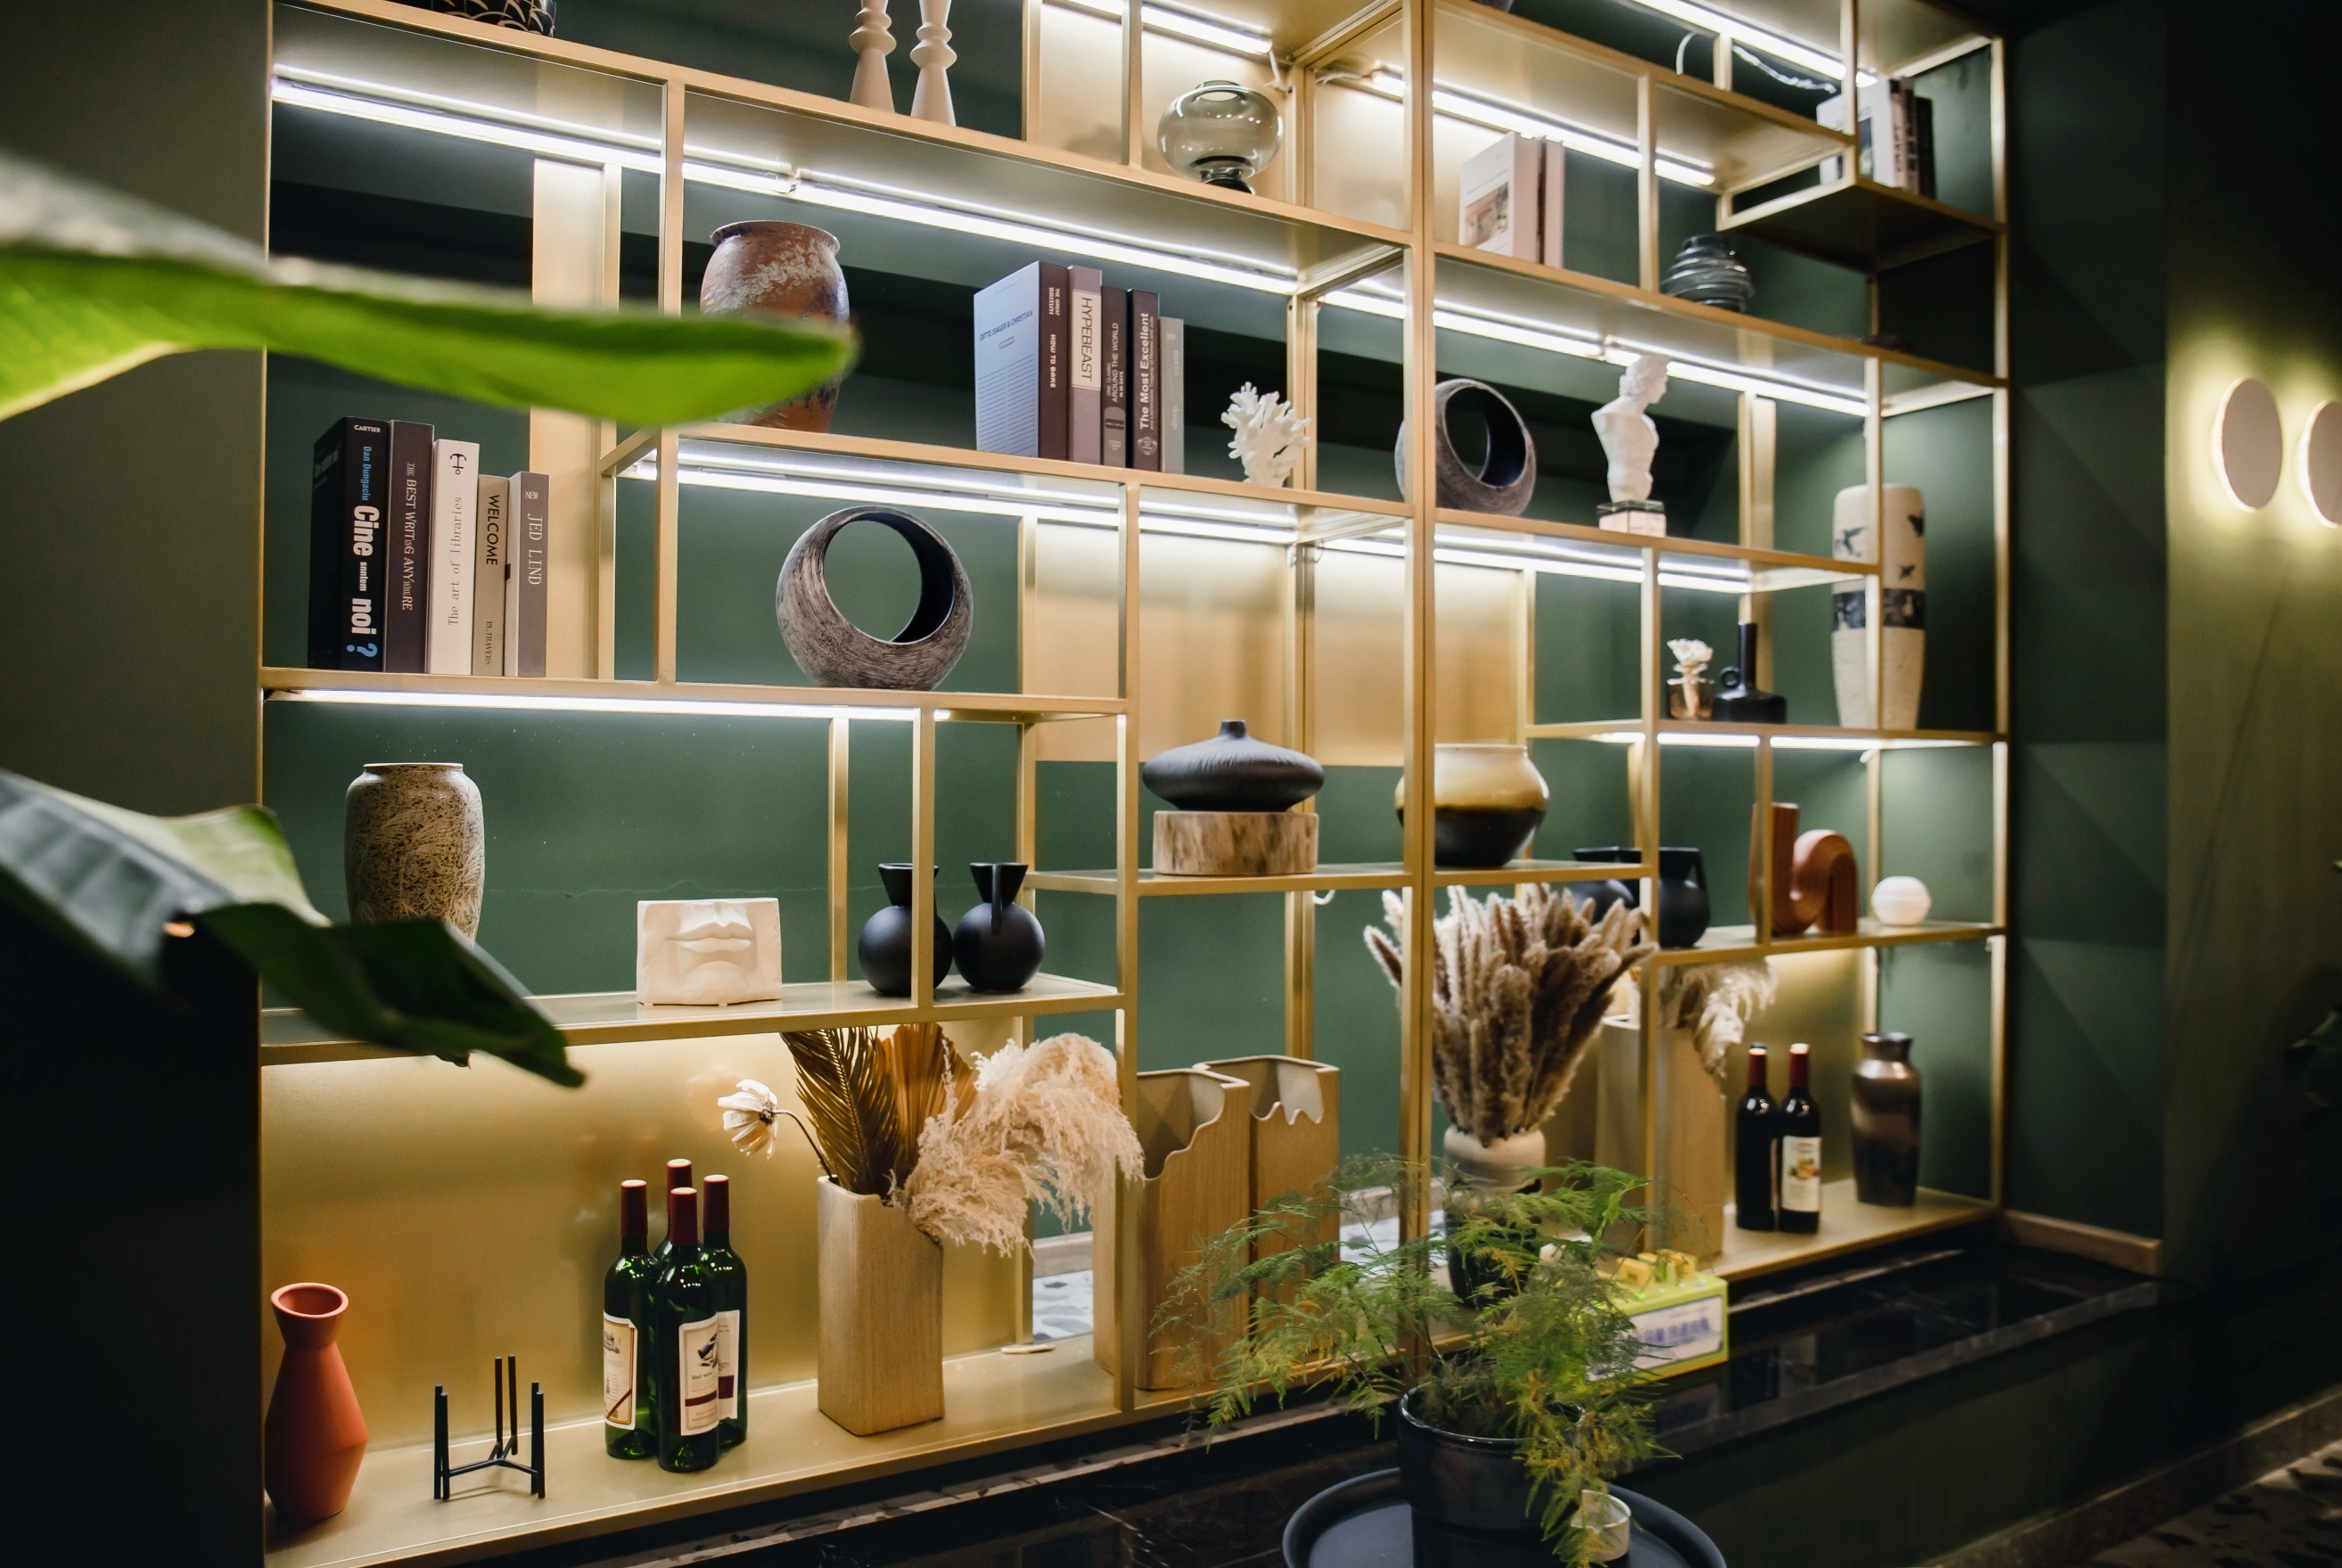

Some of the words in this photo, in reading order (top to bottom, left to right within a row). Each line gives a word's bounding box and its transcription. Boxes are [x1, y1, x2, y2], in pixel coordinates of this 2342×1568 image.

[1011, 309, 1033, 326] CHRISTIAN
[1080, 297, 1093, 382] HYPEBEAST
[1139, 313, 1150, 370] Excellent
[1139, 373, 1150, 403] Most
[354, 424, 382, 433] CARTIER
[1139, 406, 1150, 430] The
[362, 446, 372, 462] Dan
[361, 464, 371, 501] Dungaciu
[407, 462, 415, 477] THE
[406, 480, 417, 510] BEST
[525, 490, 538, 499] NEW
[353, 505, 380, 556] Cine
[449, 496, 464, 554] libraries
[485, 494, 500, 566] WELCOME
[527, 513, 544, 541] JED
[453, 560, 460, 574] of
[527, 549, 543, 585] LIND
[451, 581, 460, 601] art
[351, 597, 376, 635] noi
[448, 606, 459, 626] The
[346, 643, 378, 658] ?
